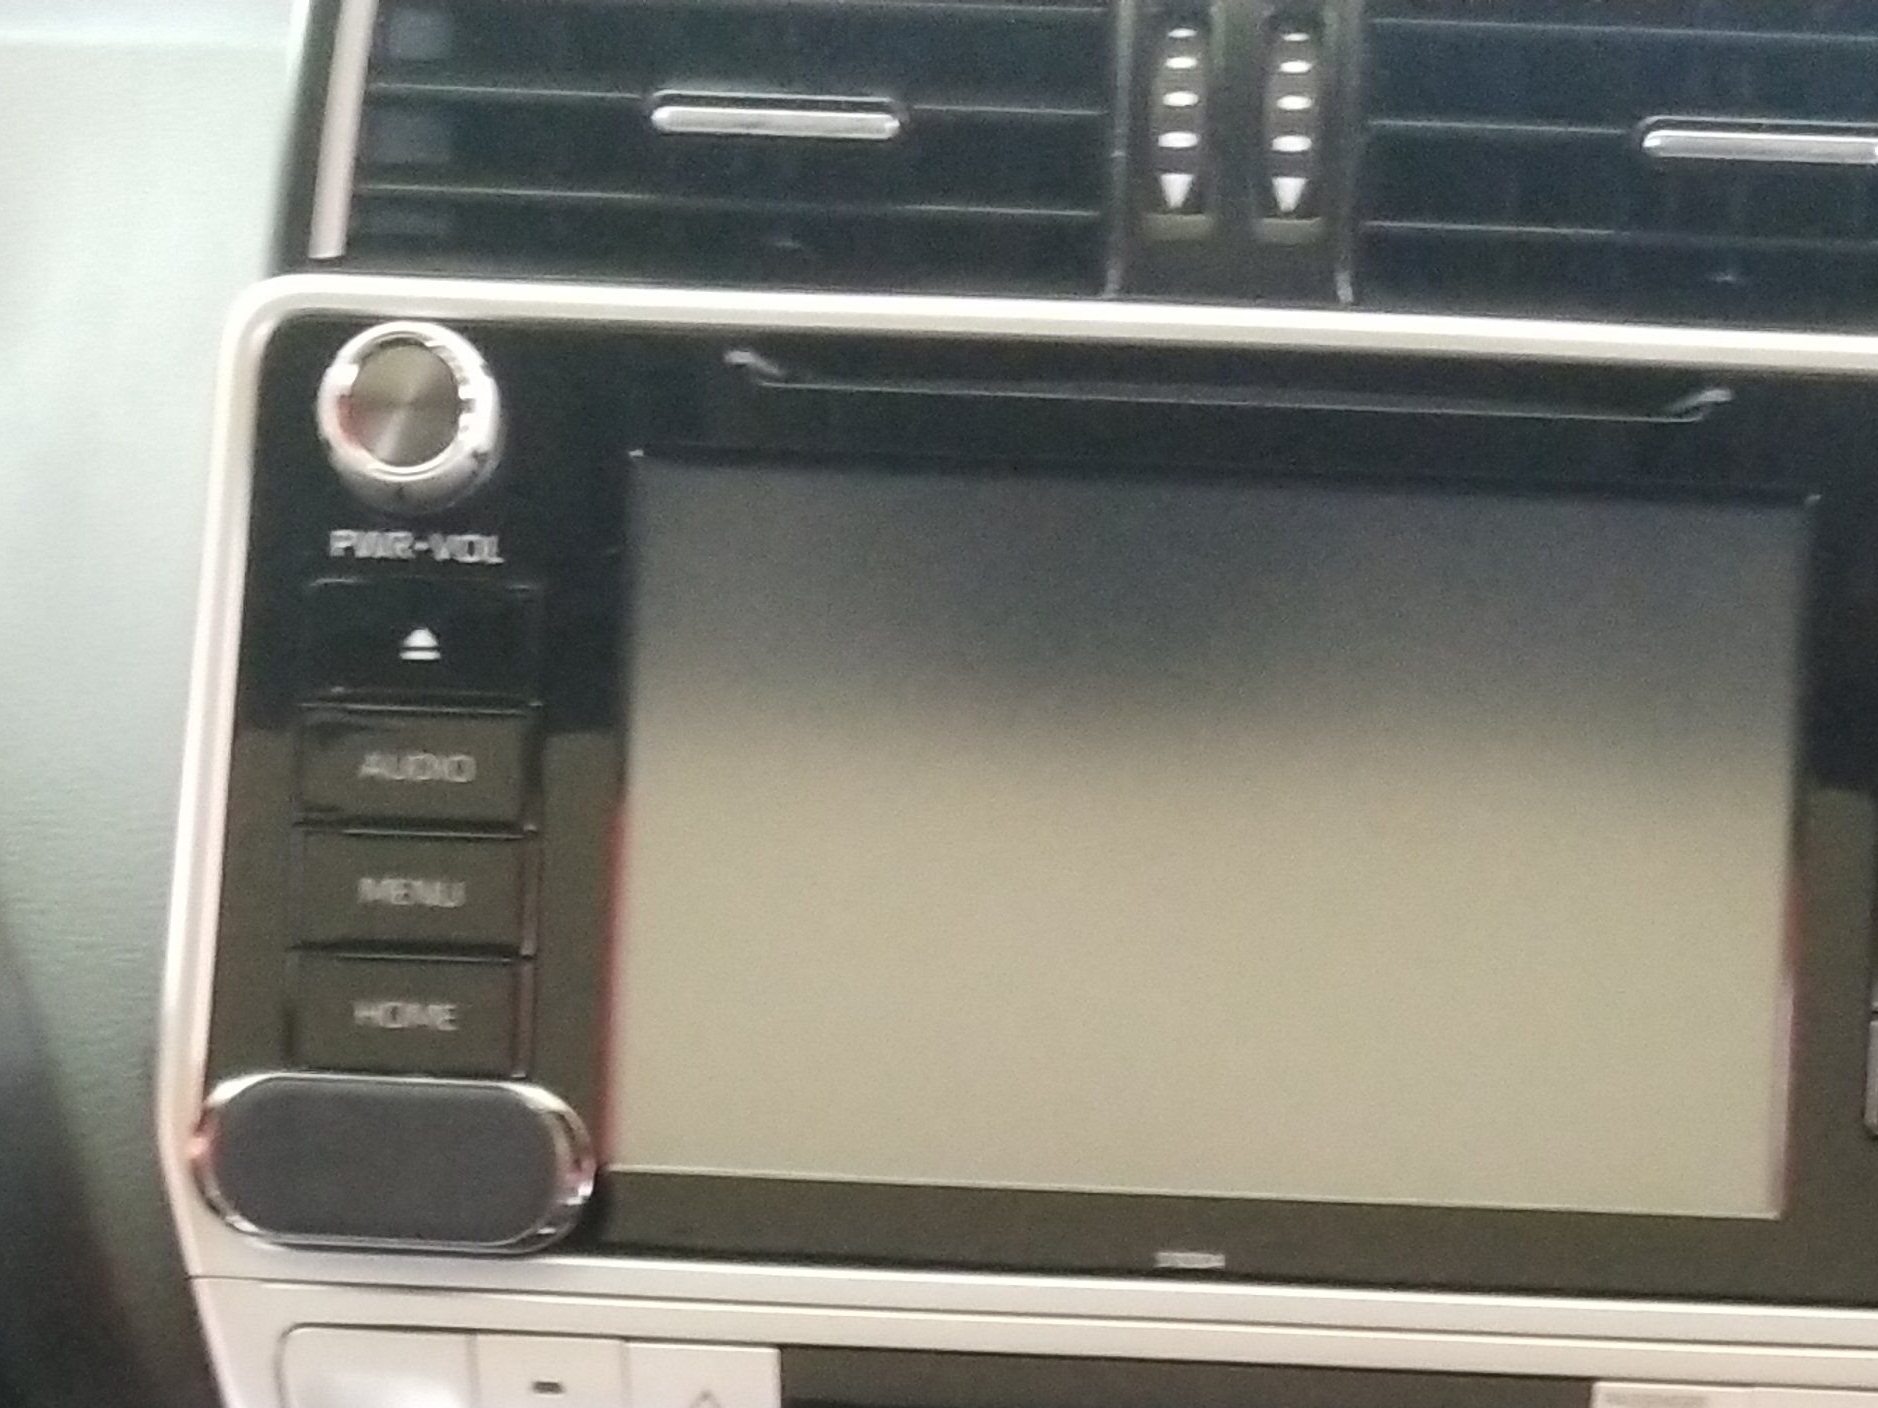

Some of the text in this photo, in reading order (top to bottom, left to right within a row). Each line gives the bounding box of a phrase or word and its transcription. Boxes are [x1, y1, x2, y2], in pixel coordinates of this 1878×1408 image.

[359, 752, 476, 783] AUDIO
[357, 877, 467, 908] MENU
[353, 1001, 459, 1031] HOME
